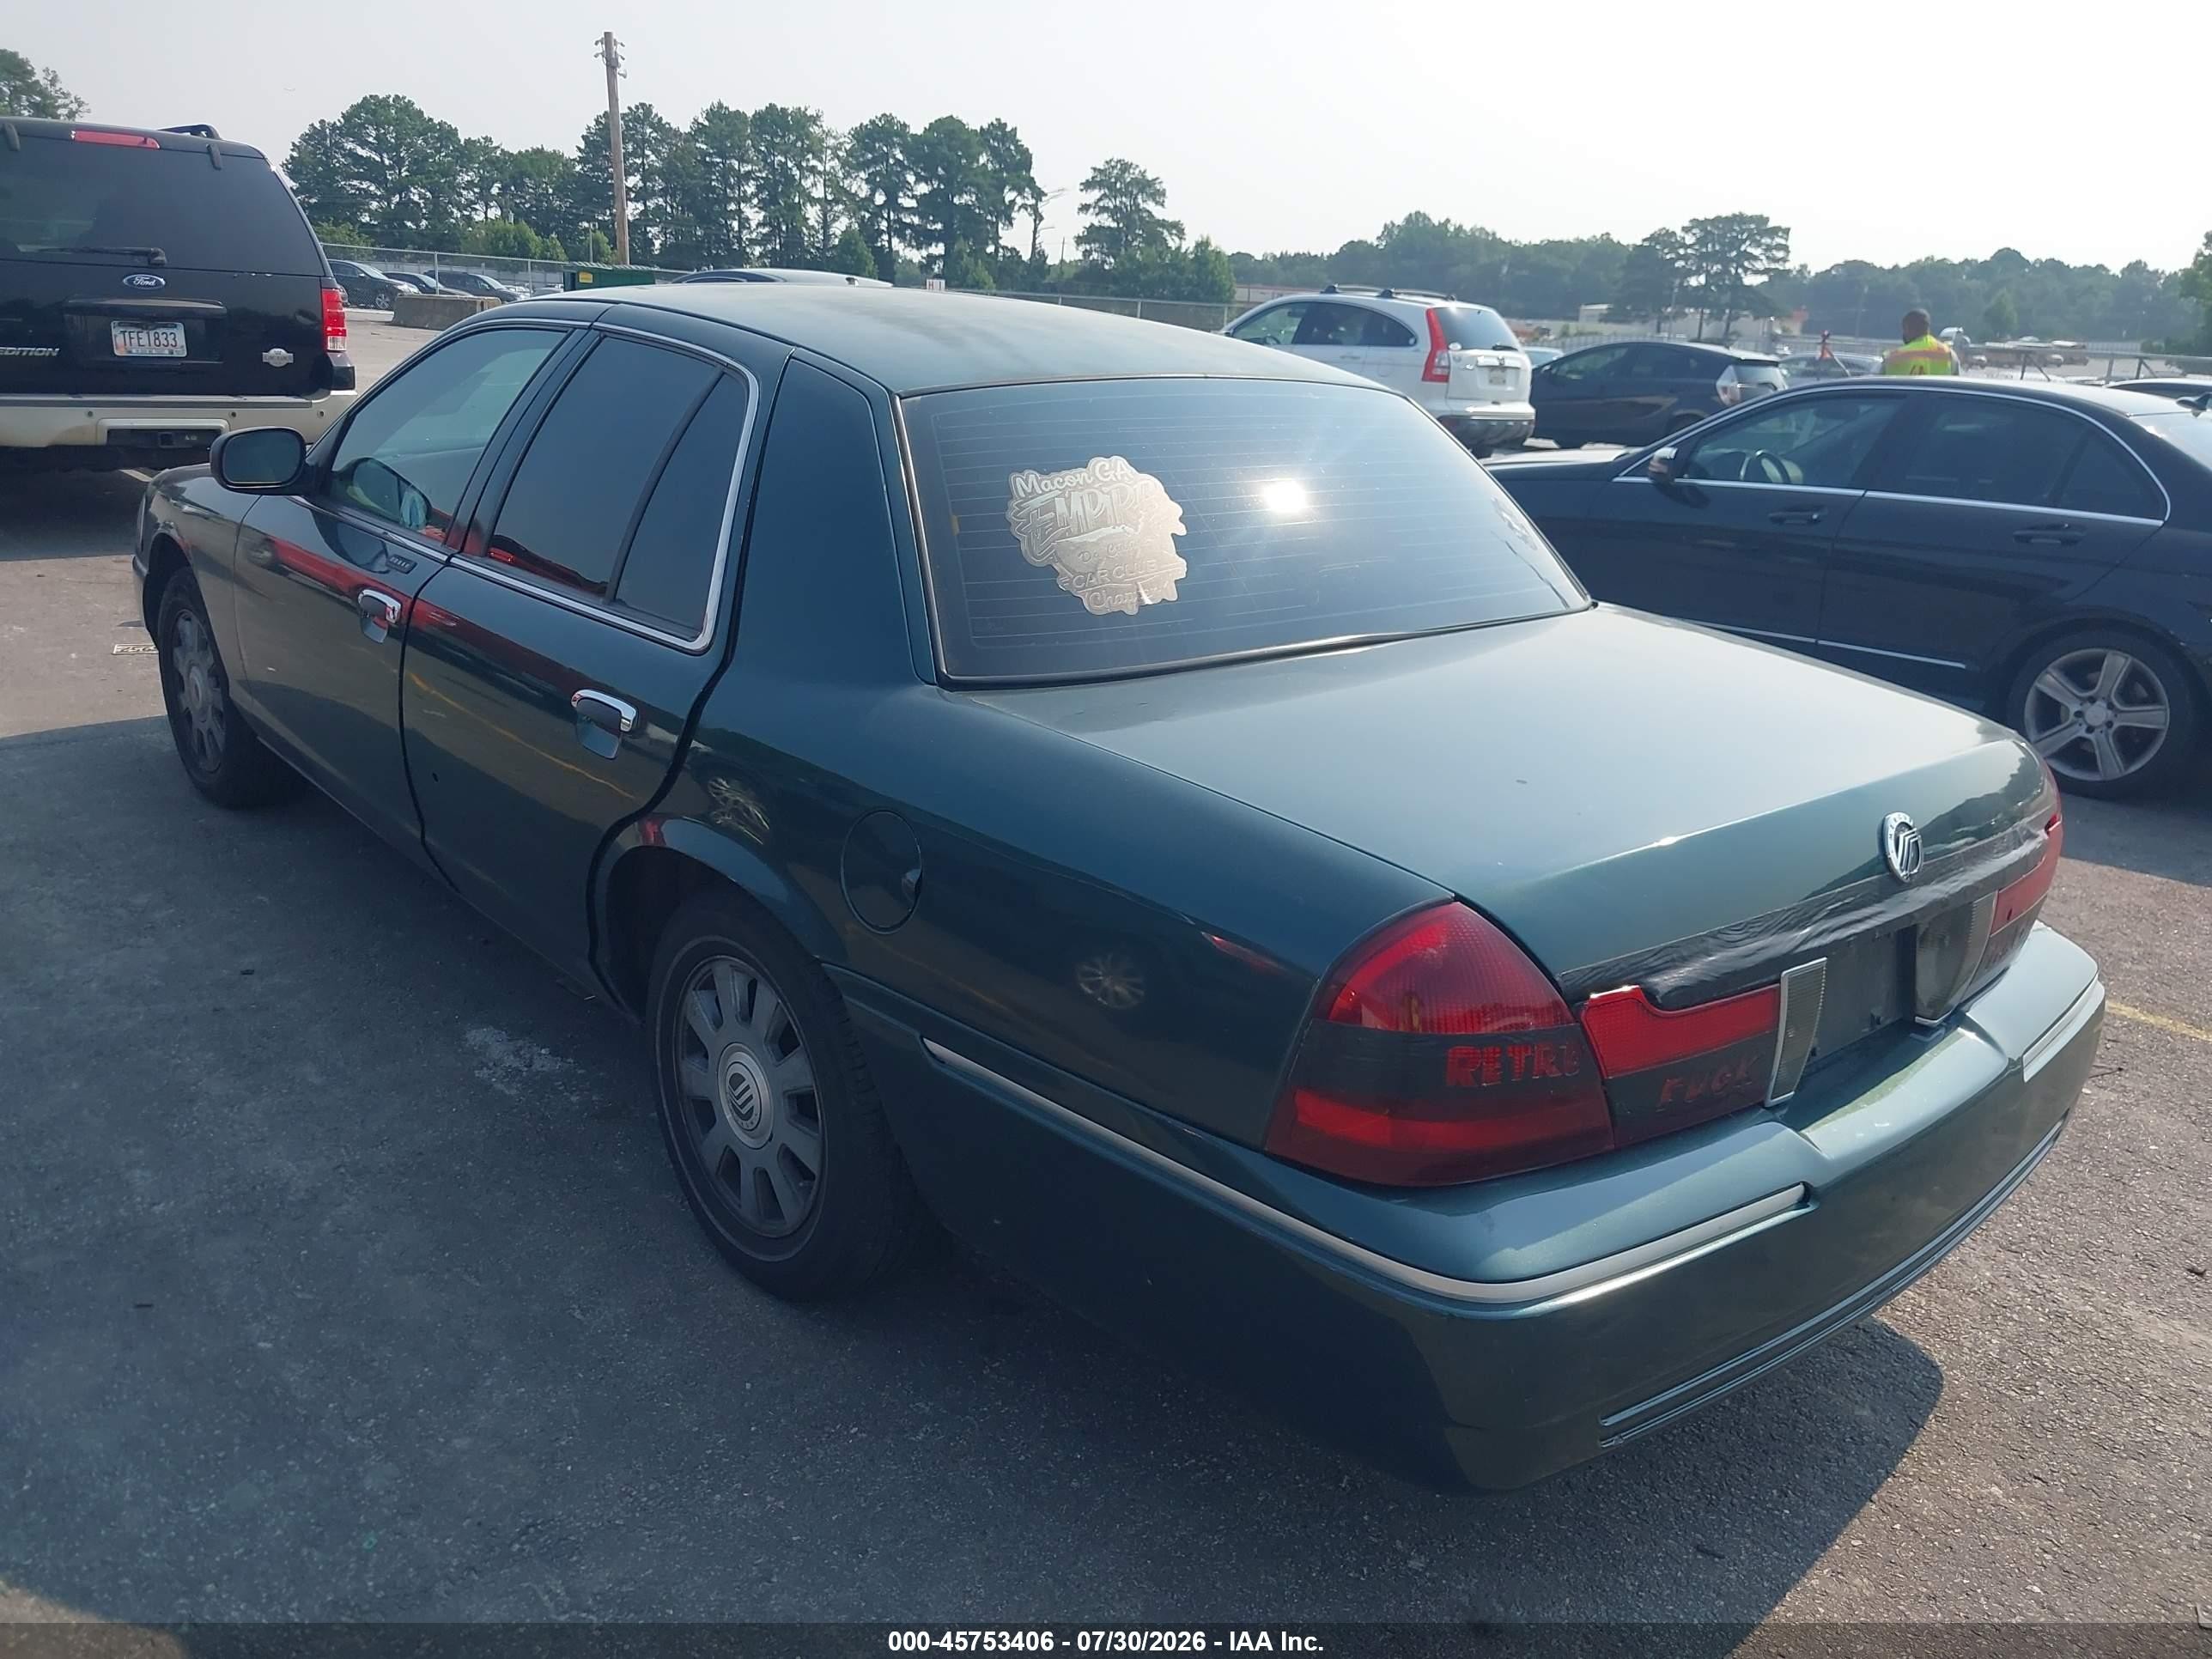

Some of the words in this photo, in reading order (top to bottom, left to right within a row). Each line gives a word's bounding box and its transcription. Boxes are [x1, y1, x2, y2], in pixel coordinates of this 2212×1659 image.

[133, 276, 156, 286] Ford
[120, 331, 178, 347] TFE1833
[1015, 472, 1092, 498] Macon
[1095, 459, 1134, 483] GA
[1072, 569, 1112, 589] CAR
